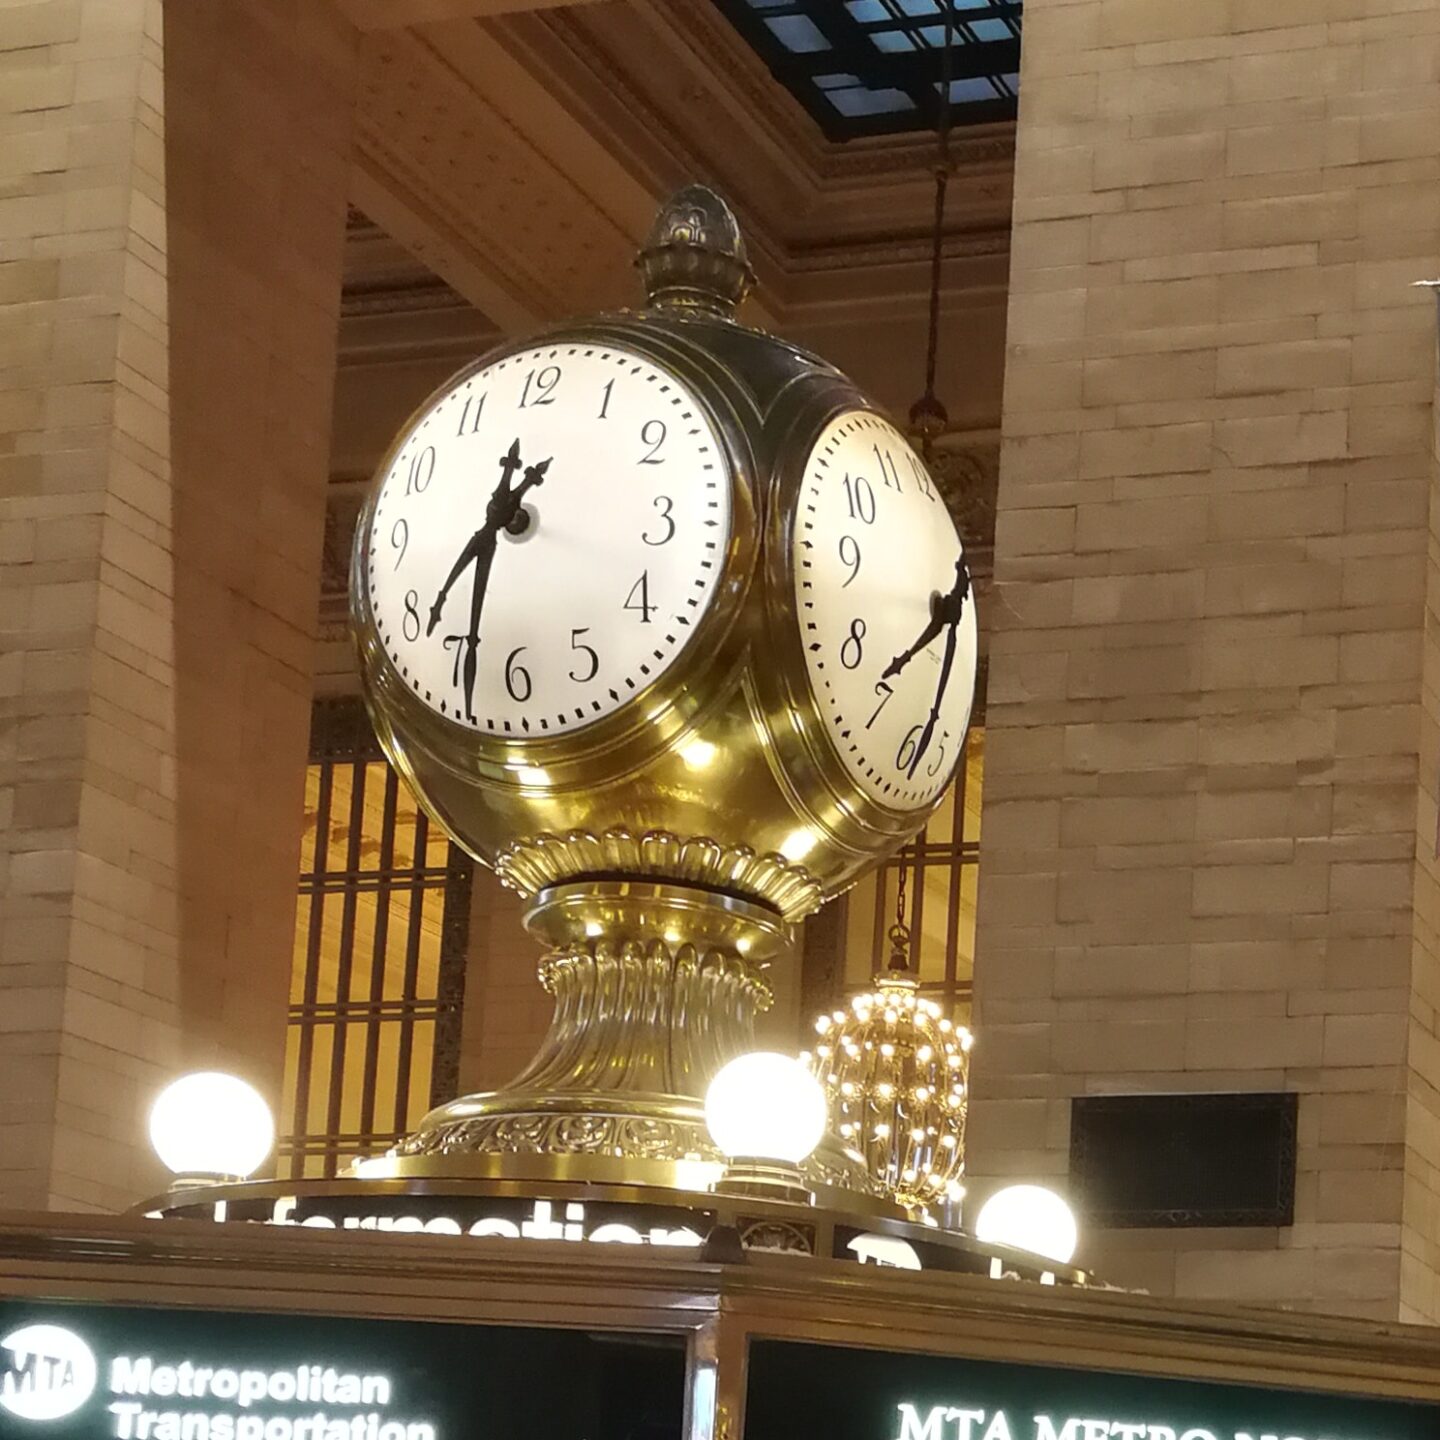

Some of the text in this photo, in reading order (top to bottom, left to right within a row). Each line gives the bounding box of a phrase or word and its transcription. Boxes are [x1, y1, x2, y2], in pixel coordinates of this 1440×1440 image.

[518, 366, 561, 409] 12
[598, 377, 615, 419] 1
[457, 391, 488, 437] 11
[636, 420, 667, 466] 2
[873, 443, 903, 493] 11
[404, 446, 436, 497] 10
[641, 495, 675, 546] 3
[843, 472, 876, 525] 10
[391, 518, 409, 571] 9
[838, 535, 861, 588] 9
[402, 589, 421, 642] 8
[623, 569, 659, 623] 4
[568, 628, 599, 682] 5
[840, 618, 867, 670] 8
[505, 646, 532, 702] 6
[865, 681, 894, 730] 7
[927, 731, 950, 778] 5
[109, 1355, 390, 1407] Metropolitan
